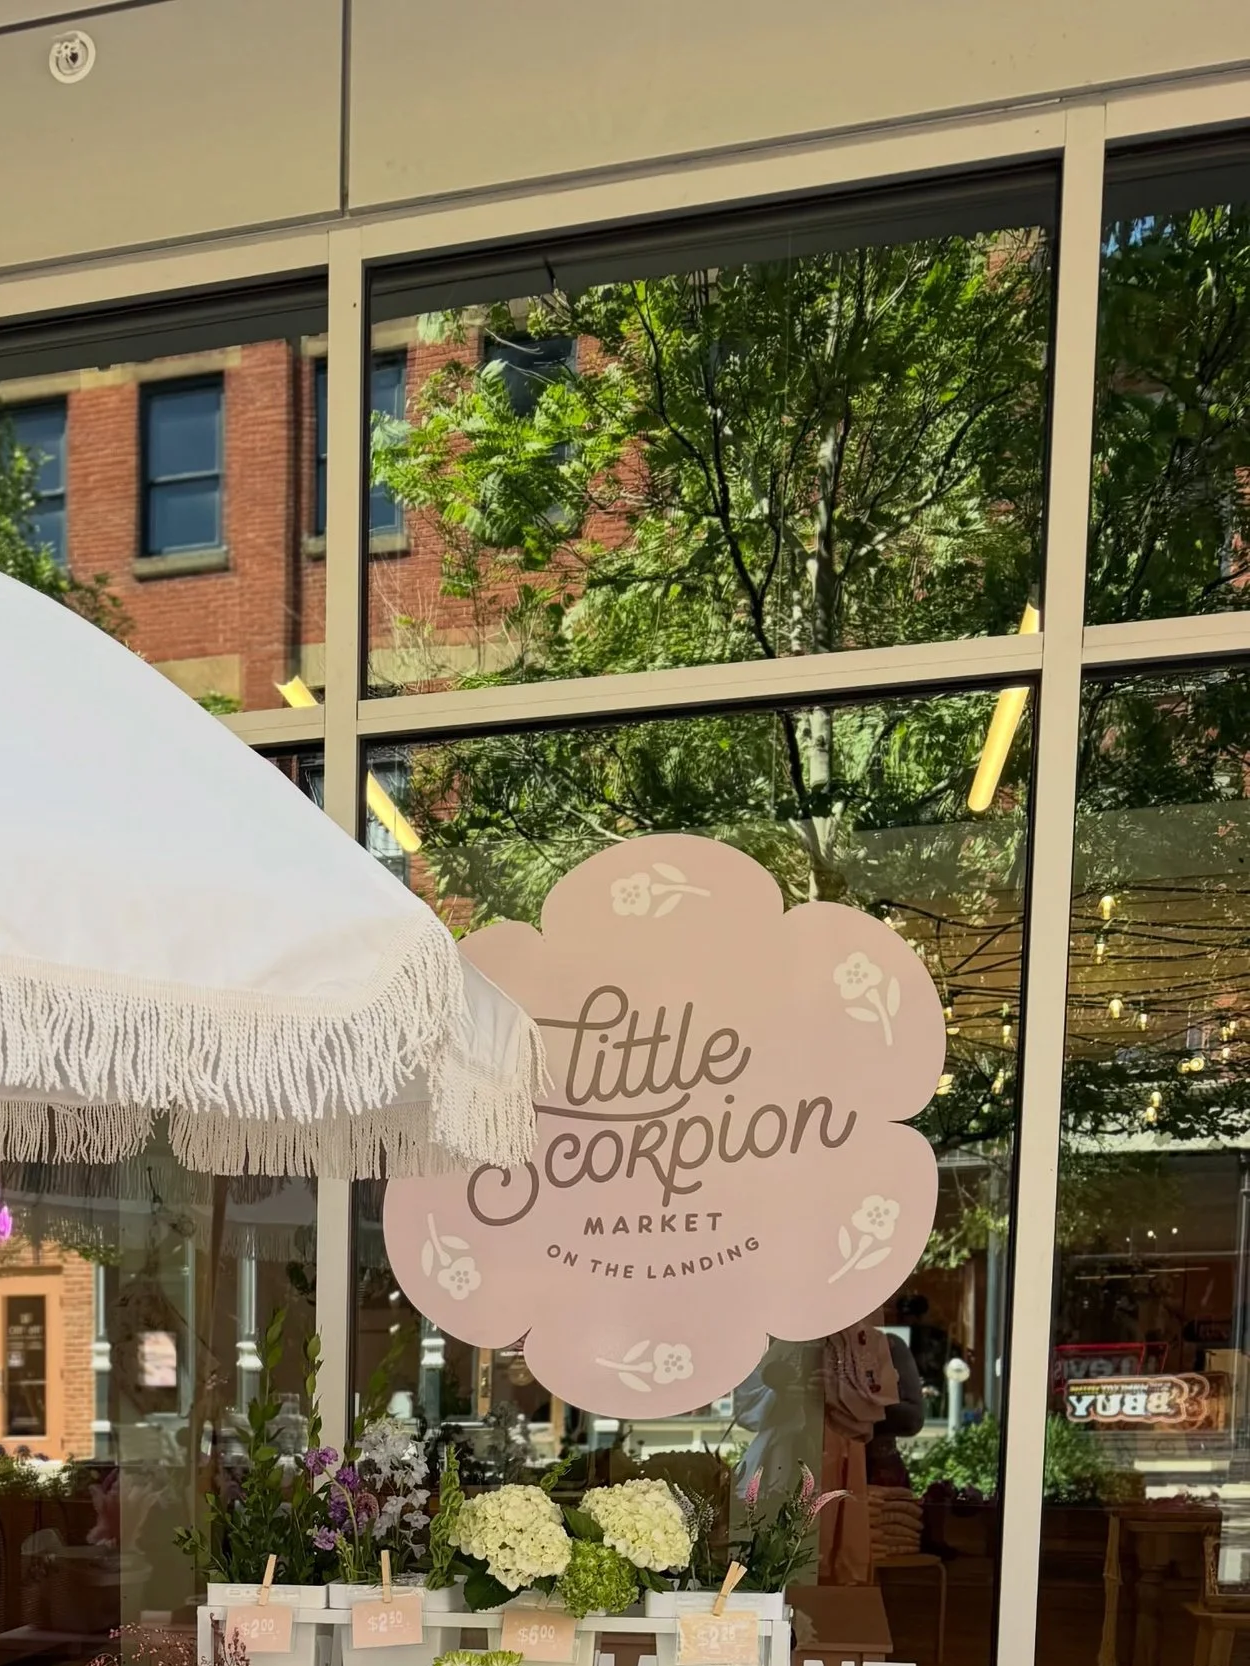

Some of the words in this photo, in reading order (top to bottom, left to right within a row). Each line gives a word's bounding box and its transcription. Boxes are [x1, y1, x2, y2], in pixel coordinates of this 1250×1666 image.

[583, 1211, 724, 1236] MARKET
[546, 1243, 579, 1268] ON
[590, 1258, 634, 1280] THE
[646, 1237, 761, 1280] LANDING
